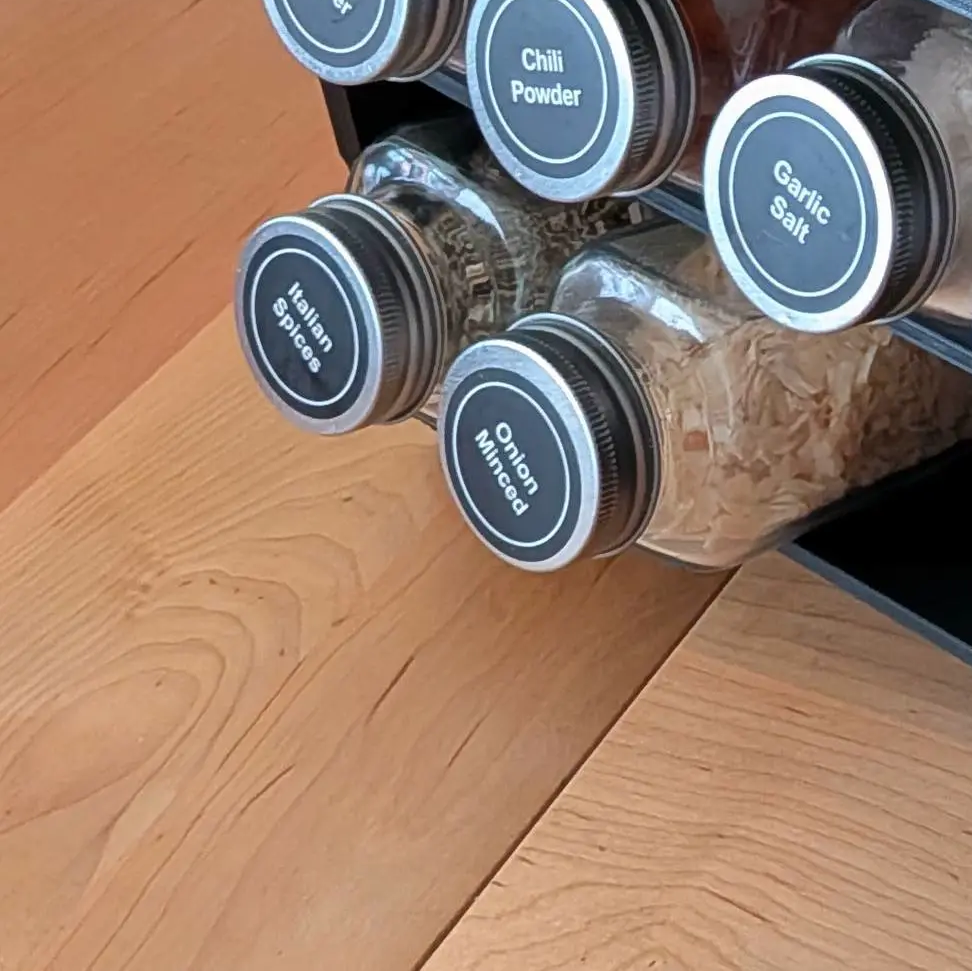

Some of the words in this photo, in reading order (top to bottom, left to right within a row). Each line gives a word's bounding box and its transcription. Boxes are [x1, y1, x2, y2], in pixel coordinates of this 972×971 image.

[510, 79, 582, 107] Powder
[521, 47, 564, 73] Chili
[769, 195, 810, 244] Salt
[773, 159, 831, 225] Garlic
[272, 297, 321, 373] Spices
[287, 281, 333, 353] Italian
[474, 428, 530, 516] Minced
[495, 421, 539, 496] Onion
